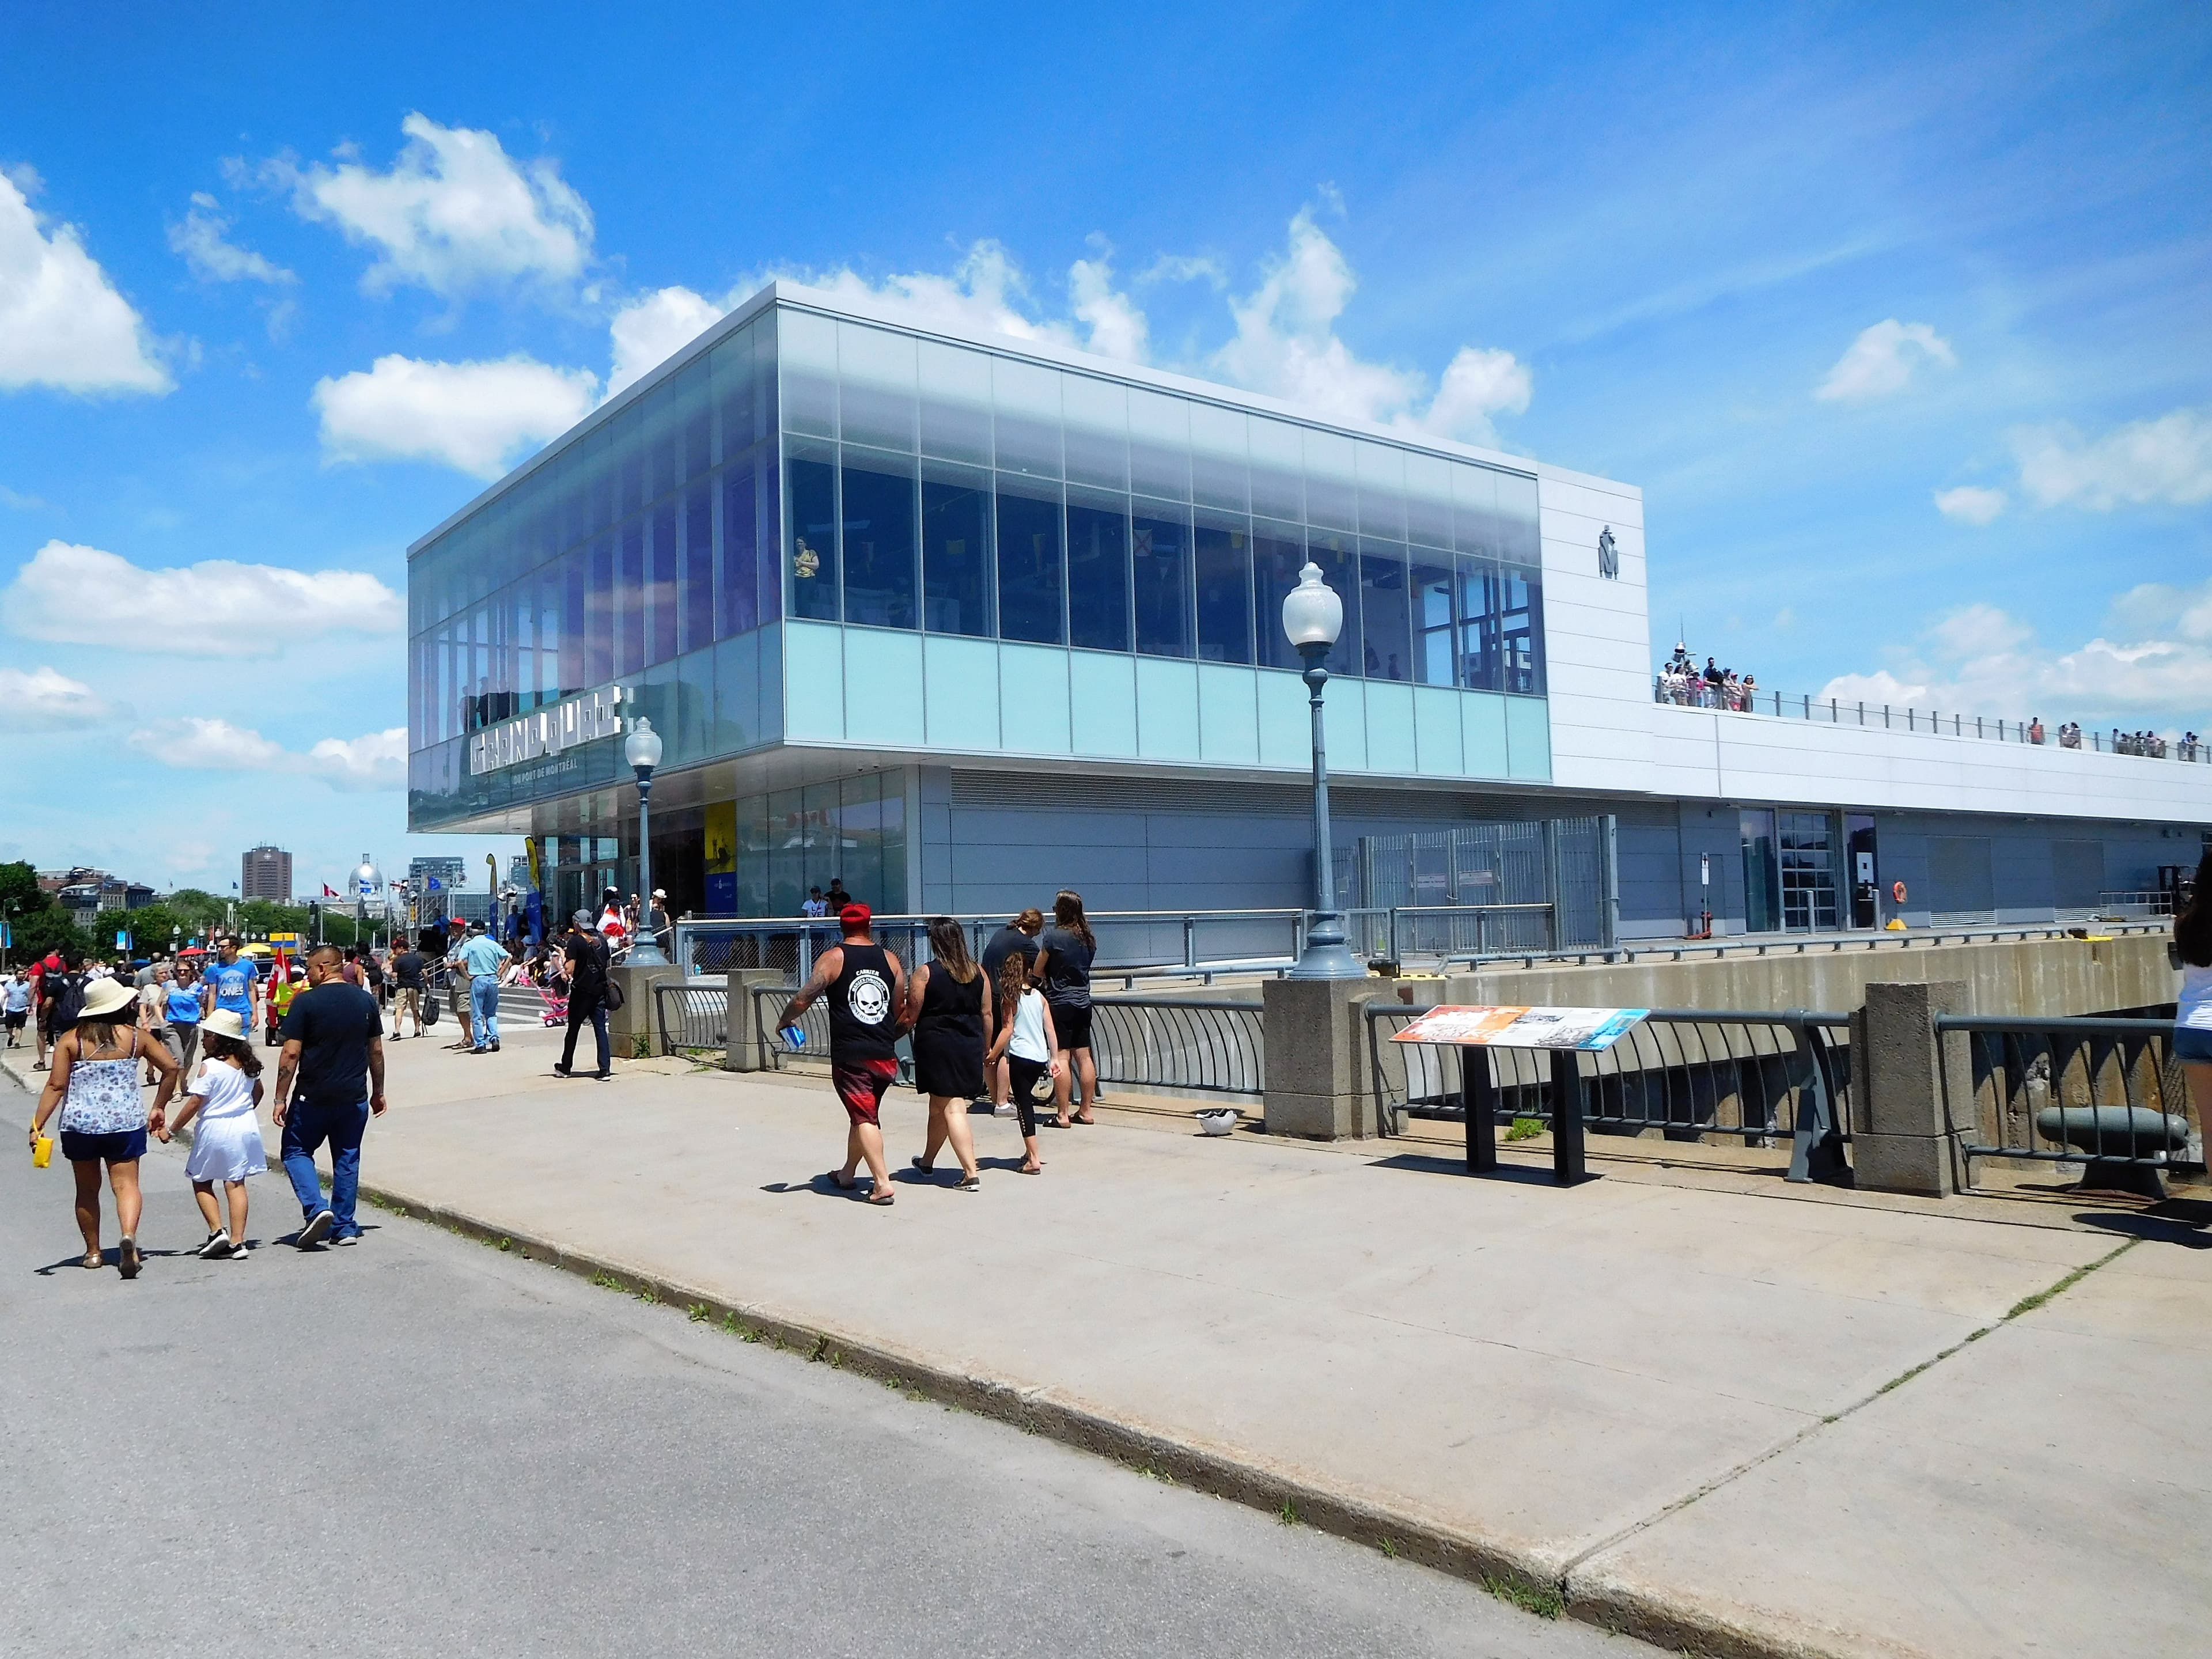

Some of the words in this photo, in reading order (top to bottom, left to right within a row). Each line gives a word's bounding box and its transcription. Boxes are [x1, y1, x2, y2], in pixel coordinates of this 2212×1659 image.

[471, 713, 547, 775] GRAND
[521, 770, 536, 782] PORT
[537, 767, 544, 778] DE
[546, 757, 577, 777] MONTRÉAL
